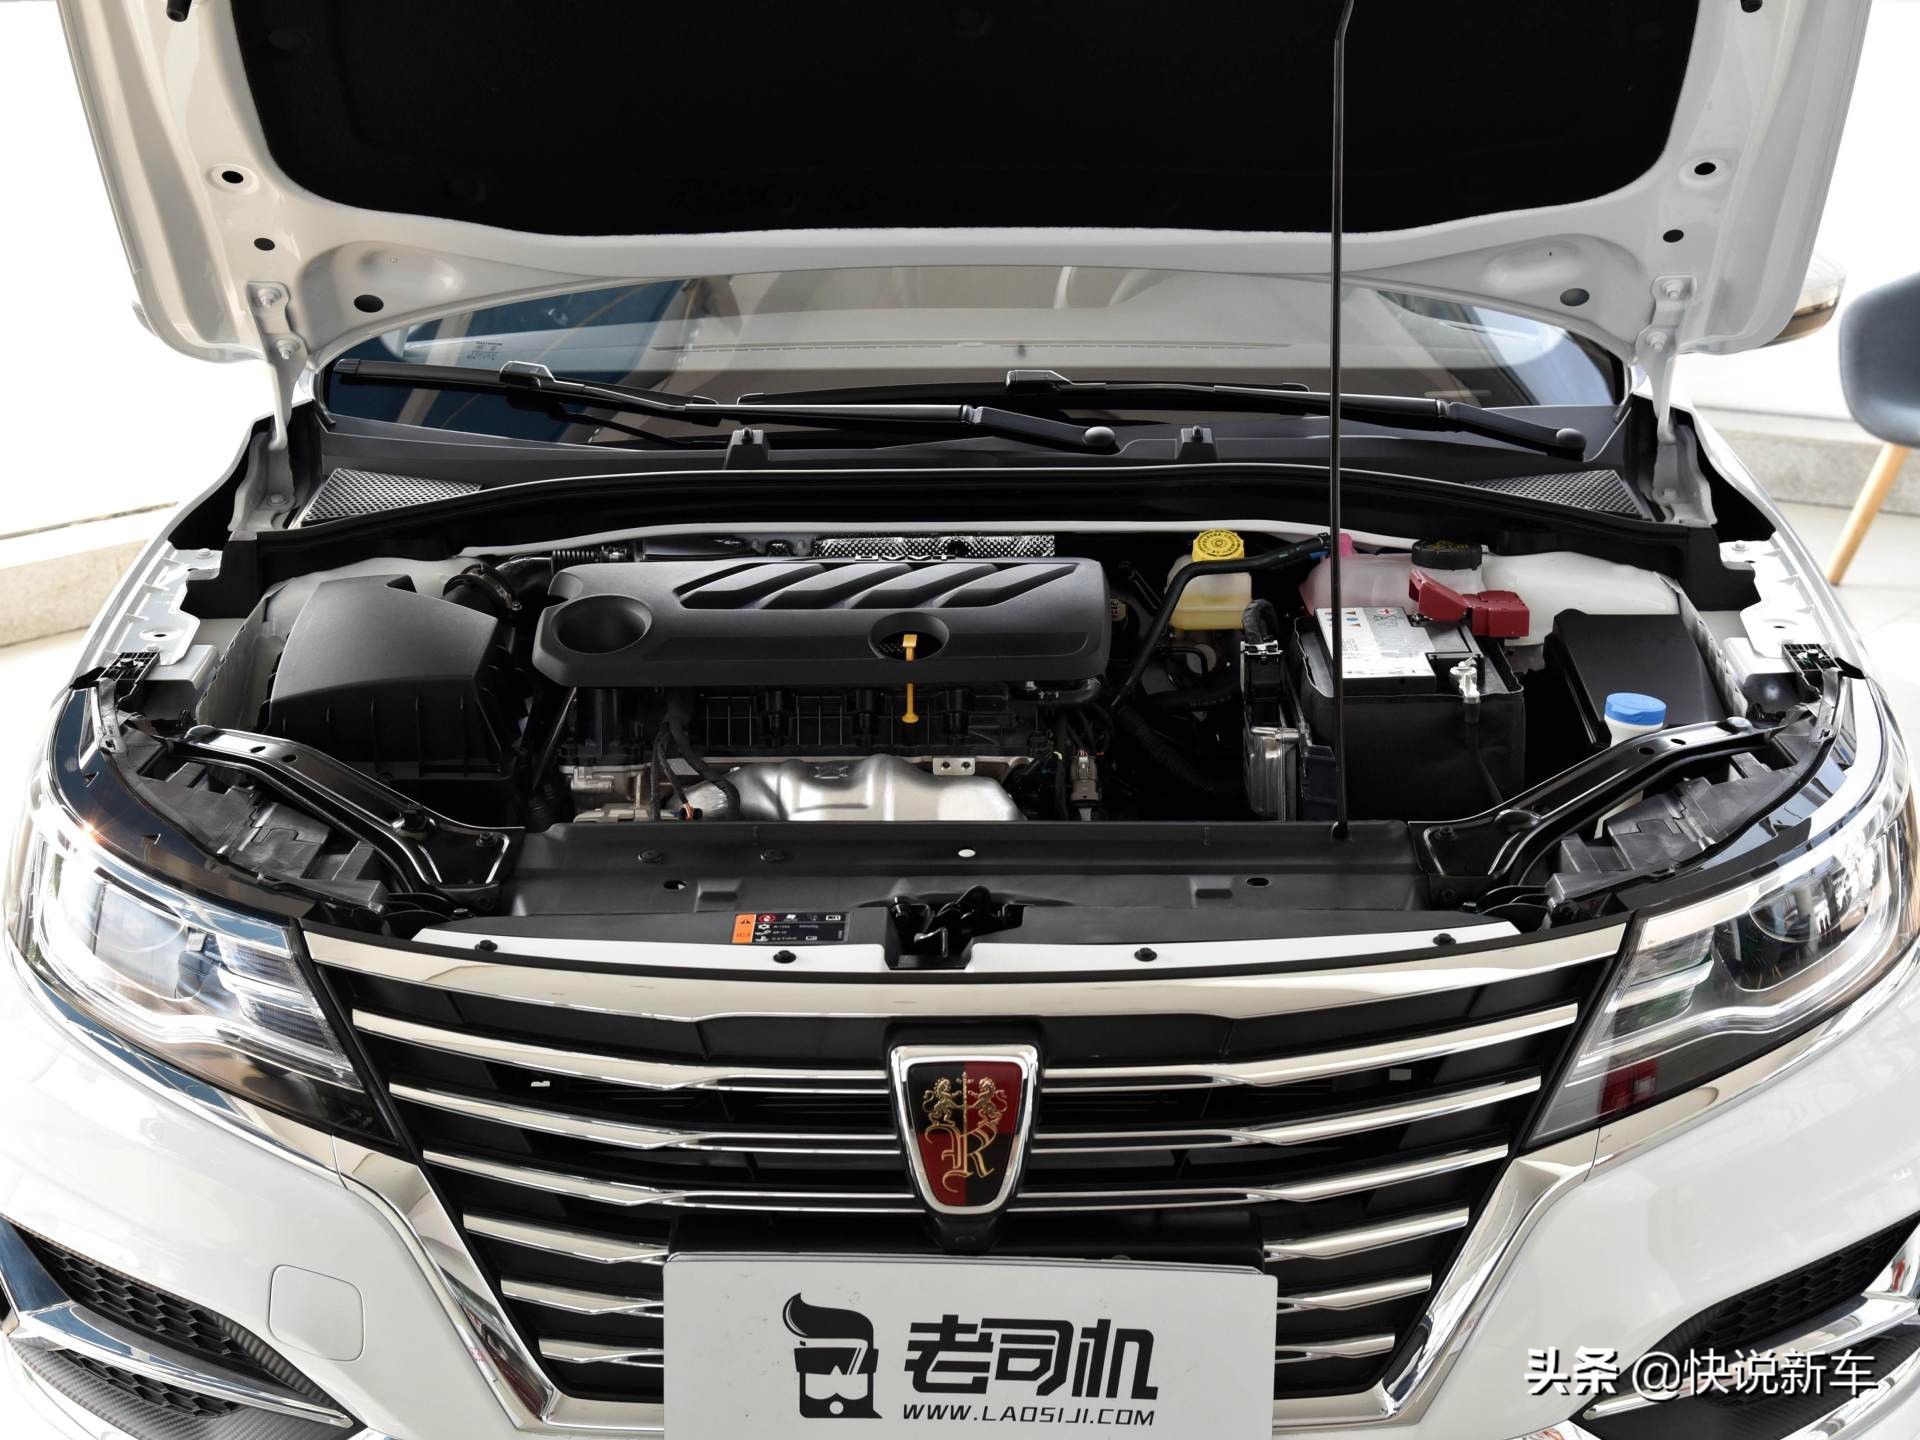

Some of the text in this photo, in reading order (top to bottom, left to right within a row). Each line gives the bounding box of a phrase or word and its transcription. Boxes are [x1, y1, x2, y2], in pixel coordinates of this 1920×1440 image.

[904, 1314, 1159, 1401] 老司机
[903, 1404, 1155, 1426] WWW.LAOSIJI.COM
